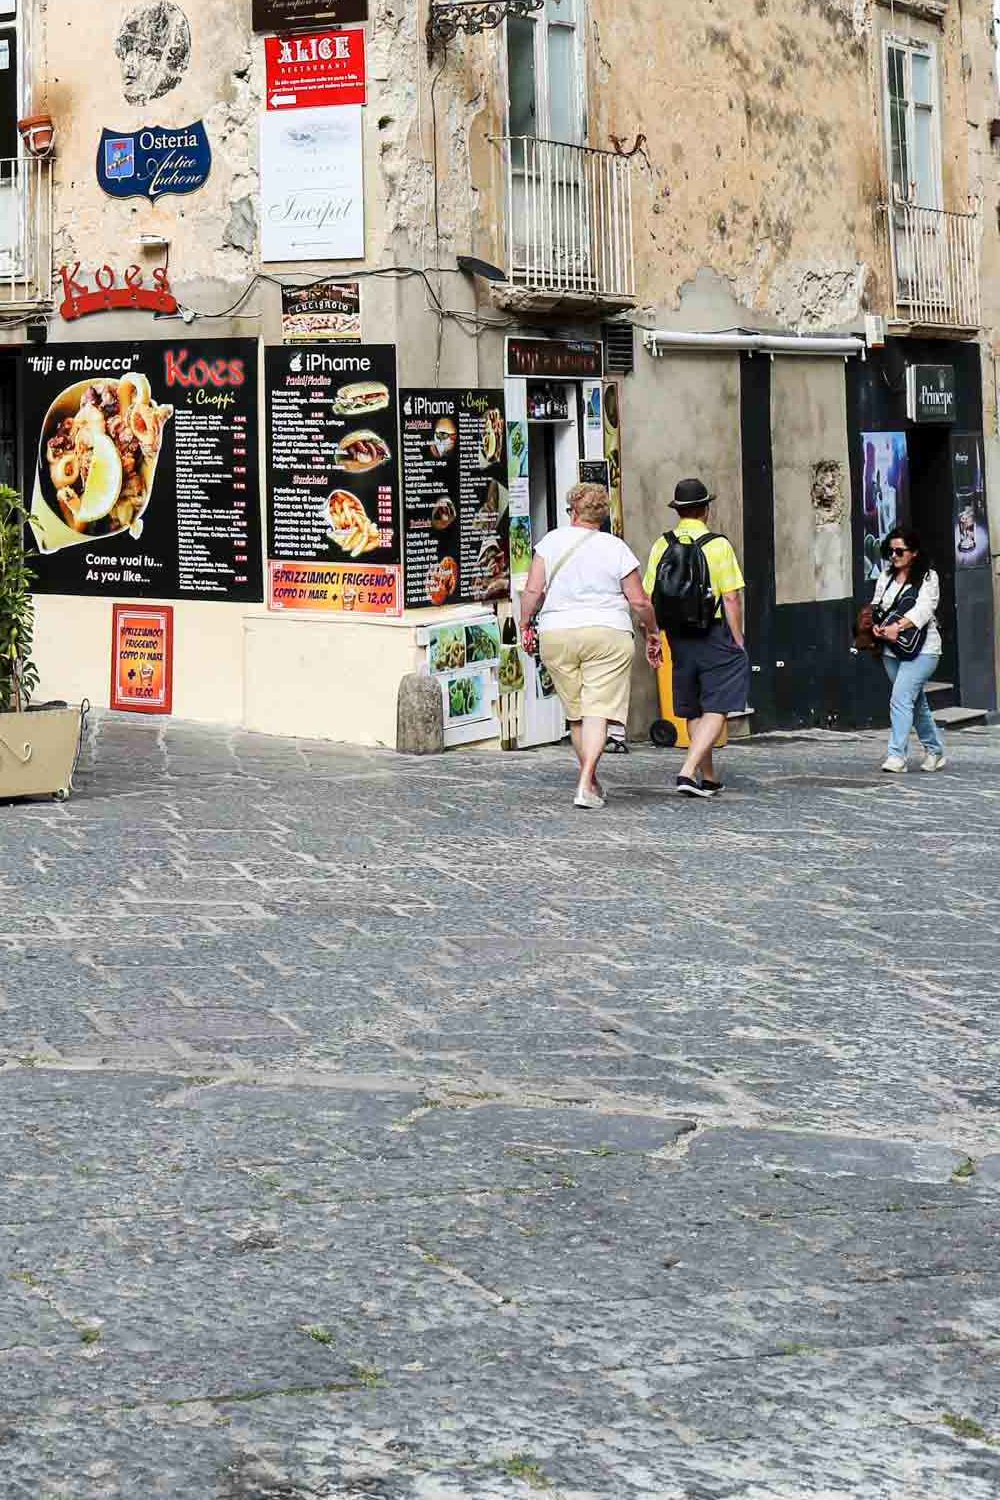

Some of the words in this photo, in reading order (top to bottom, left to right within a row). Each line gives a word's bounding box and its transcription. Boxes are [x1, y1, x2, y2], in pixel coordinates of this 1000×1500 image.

[277, 36, 351, 64] ALICE
[140, 130, 198, 150] Osteria
[56, 360, 65, 372] e
[165, 350, 245, 387] Koes
[306, 353, 371, 372] iPhame
[186, 392, 192, 405] i
[195, 388, 236, 410] Cuoppi
[414, 397, 455, 415] iPhame
[921, 384, 953, 415] Principe
[85, 553, 118, 566] Come
[120, 555, 143, 567] vuoi
[144, 556, 163, 567] tu...
[85, 569, 99, 581] As
[101, 571, 121, 584] you
[123, 570, 151, 583] like...
[273, 570, 340, 585] SPRIZZIAMOCI
[342, 572, 395, 587] FRIGGENDO
[273, 588, 297, 599] COPPO
[299, 589, 306, 599] DI
[308, 590, 328, 600] MARE
[367, 592, 393, 605] 12,00
